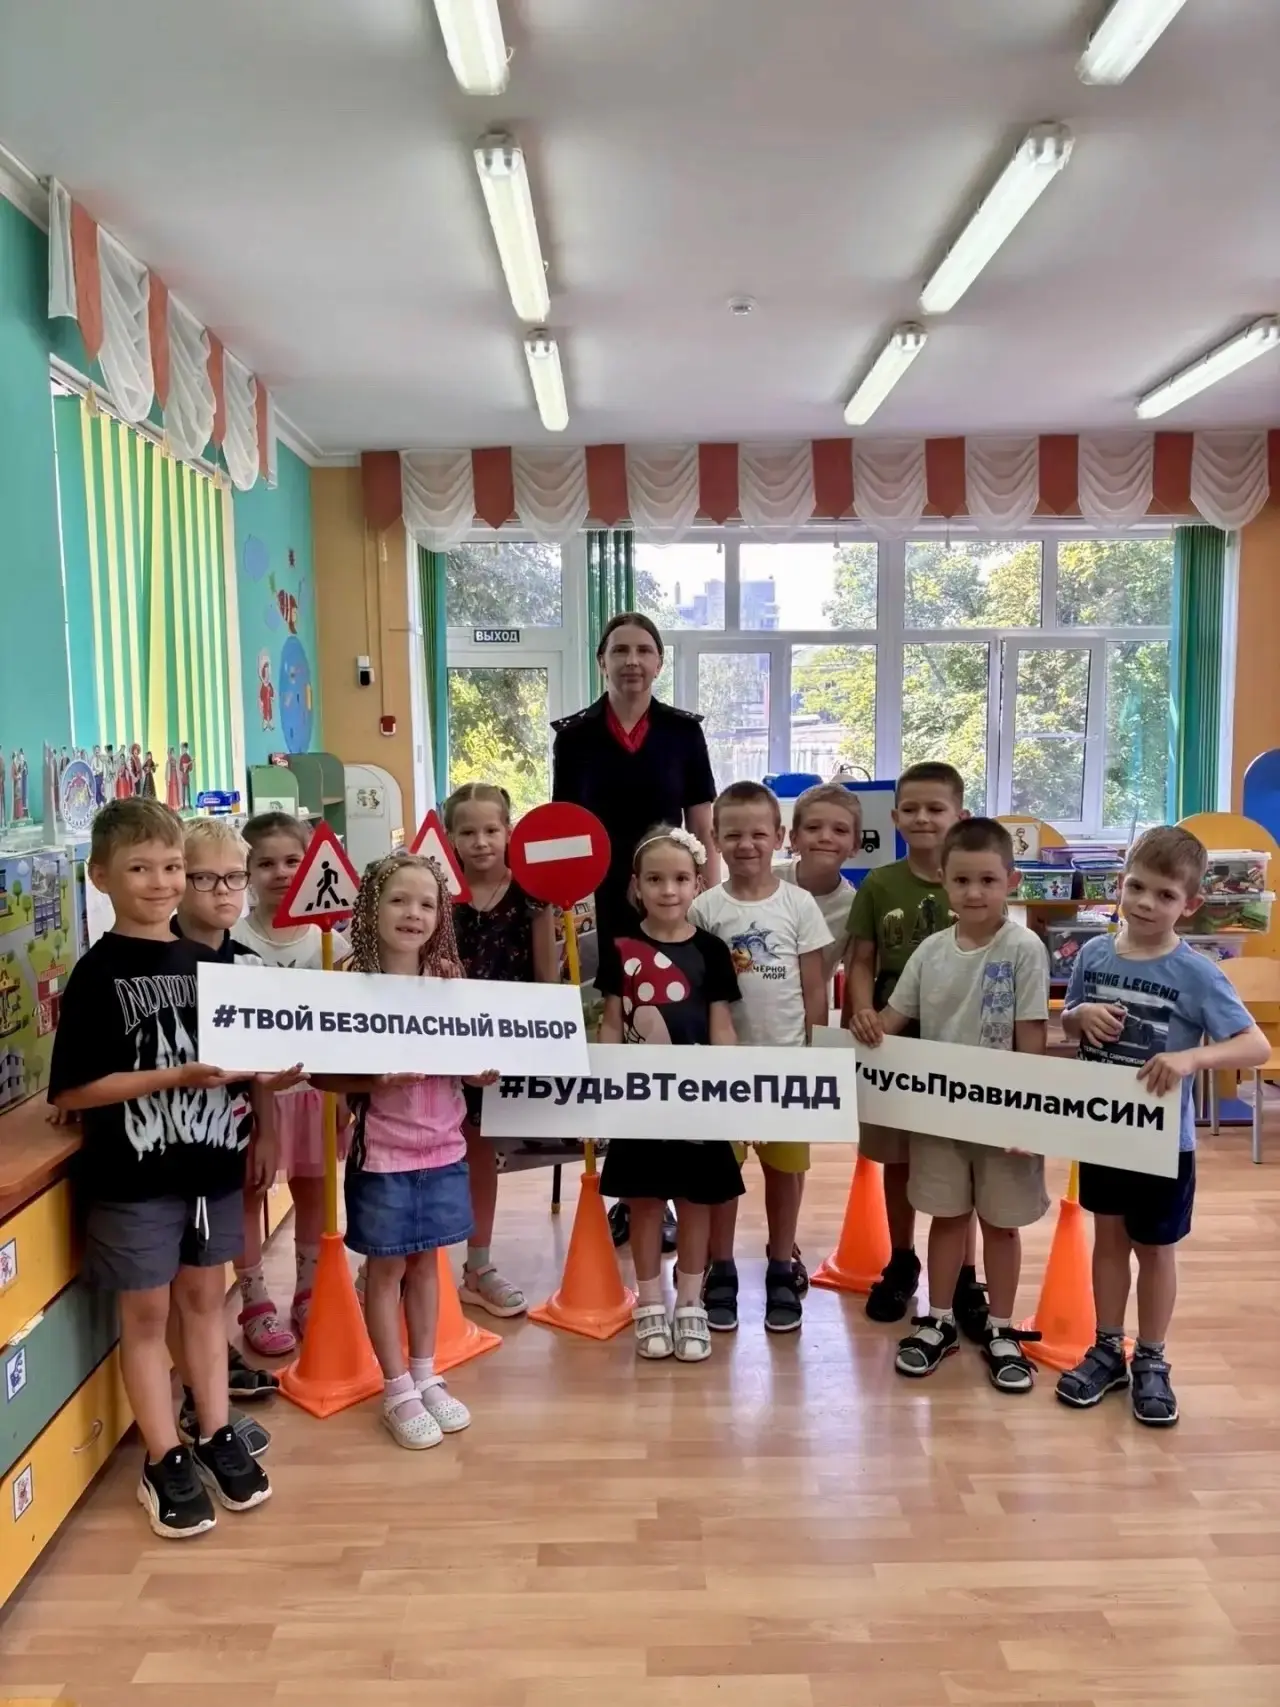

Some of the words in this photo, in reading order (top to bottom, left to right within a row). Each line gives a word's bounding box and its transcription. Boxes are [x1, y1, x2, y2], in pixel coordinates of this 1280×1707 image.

[475, 630, 518, 641] ВЫХОД
[762, 972, 787, 980] МОРЕ
[1122, 976, 1180, 1002] LEGEND
[212, 1004, 313, 1031] #ТВОЙ
[319, 1011, 495, 1038] БЕЗОПАСНЫЙ
[498, 1018, 577, 1039] ВЫБОР
[499, 1072, 841, 1110] #БудьВТемеПДД
